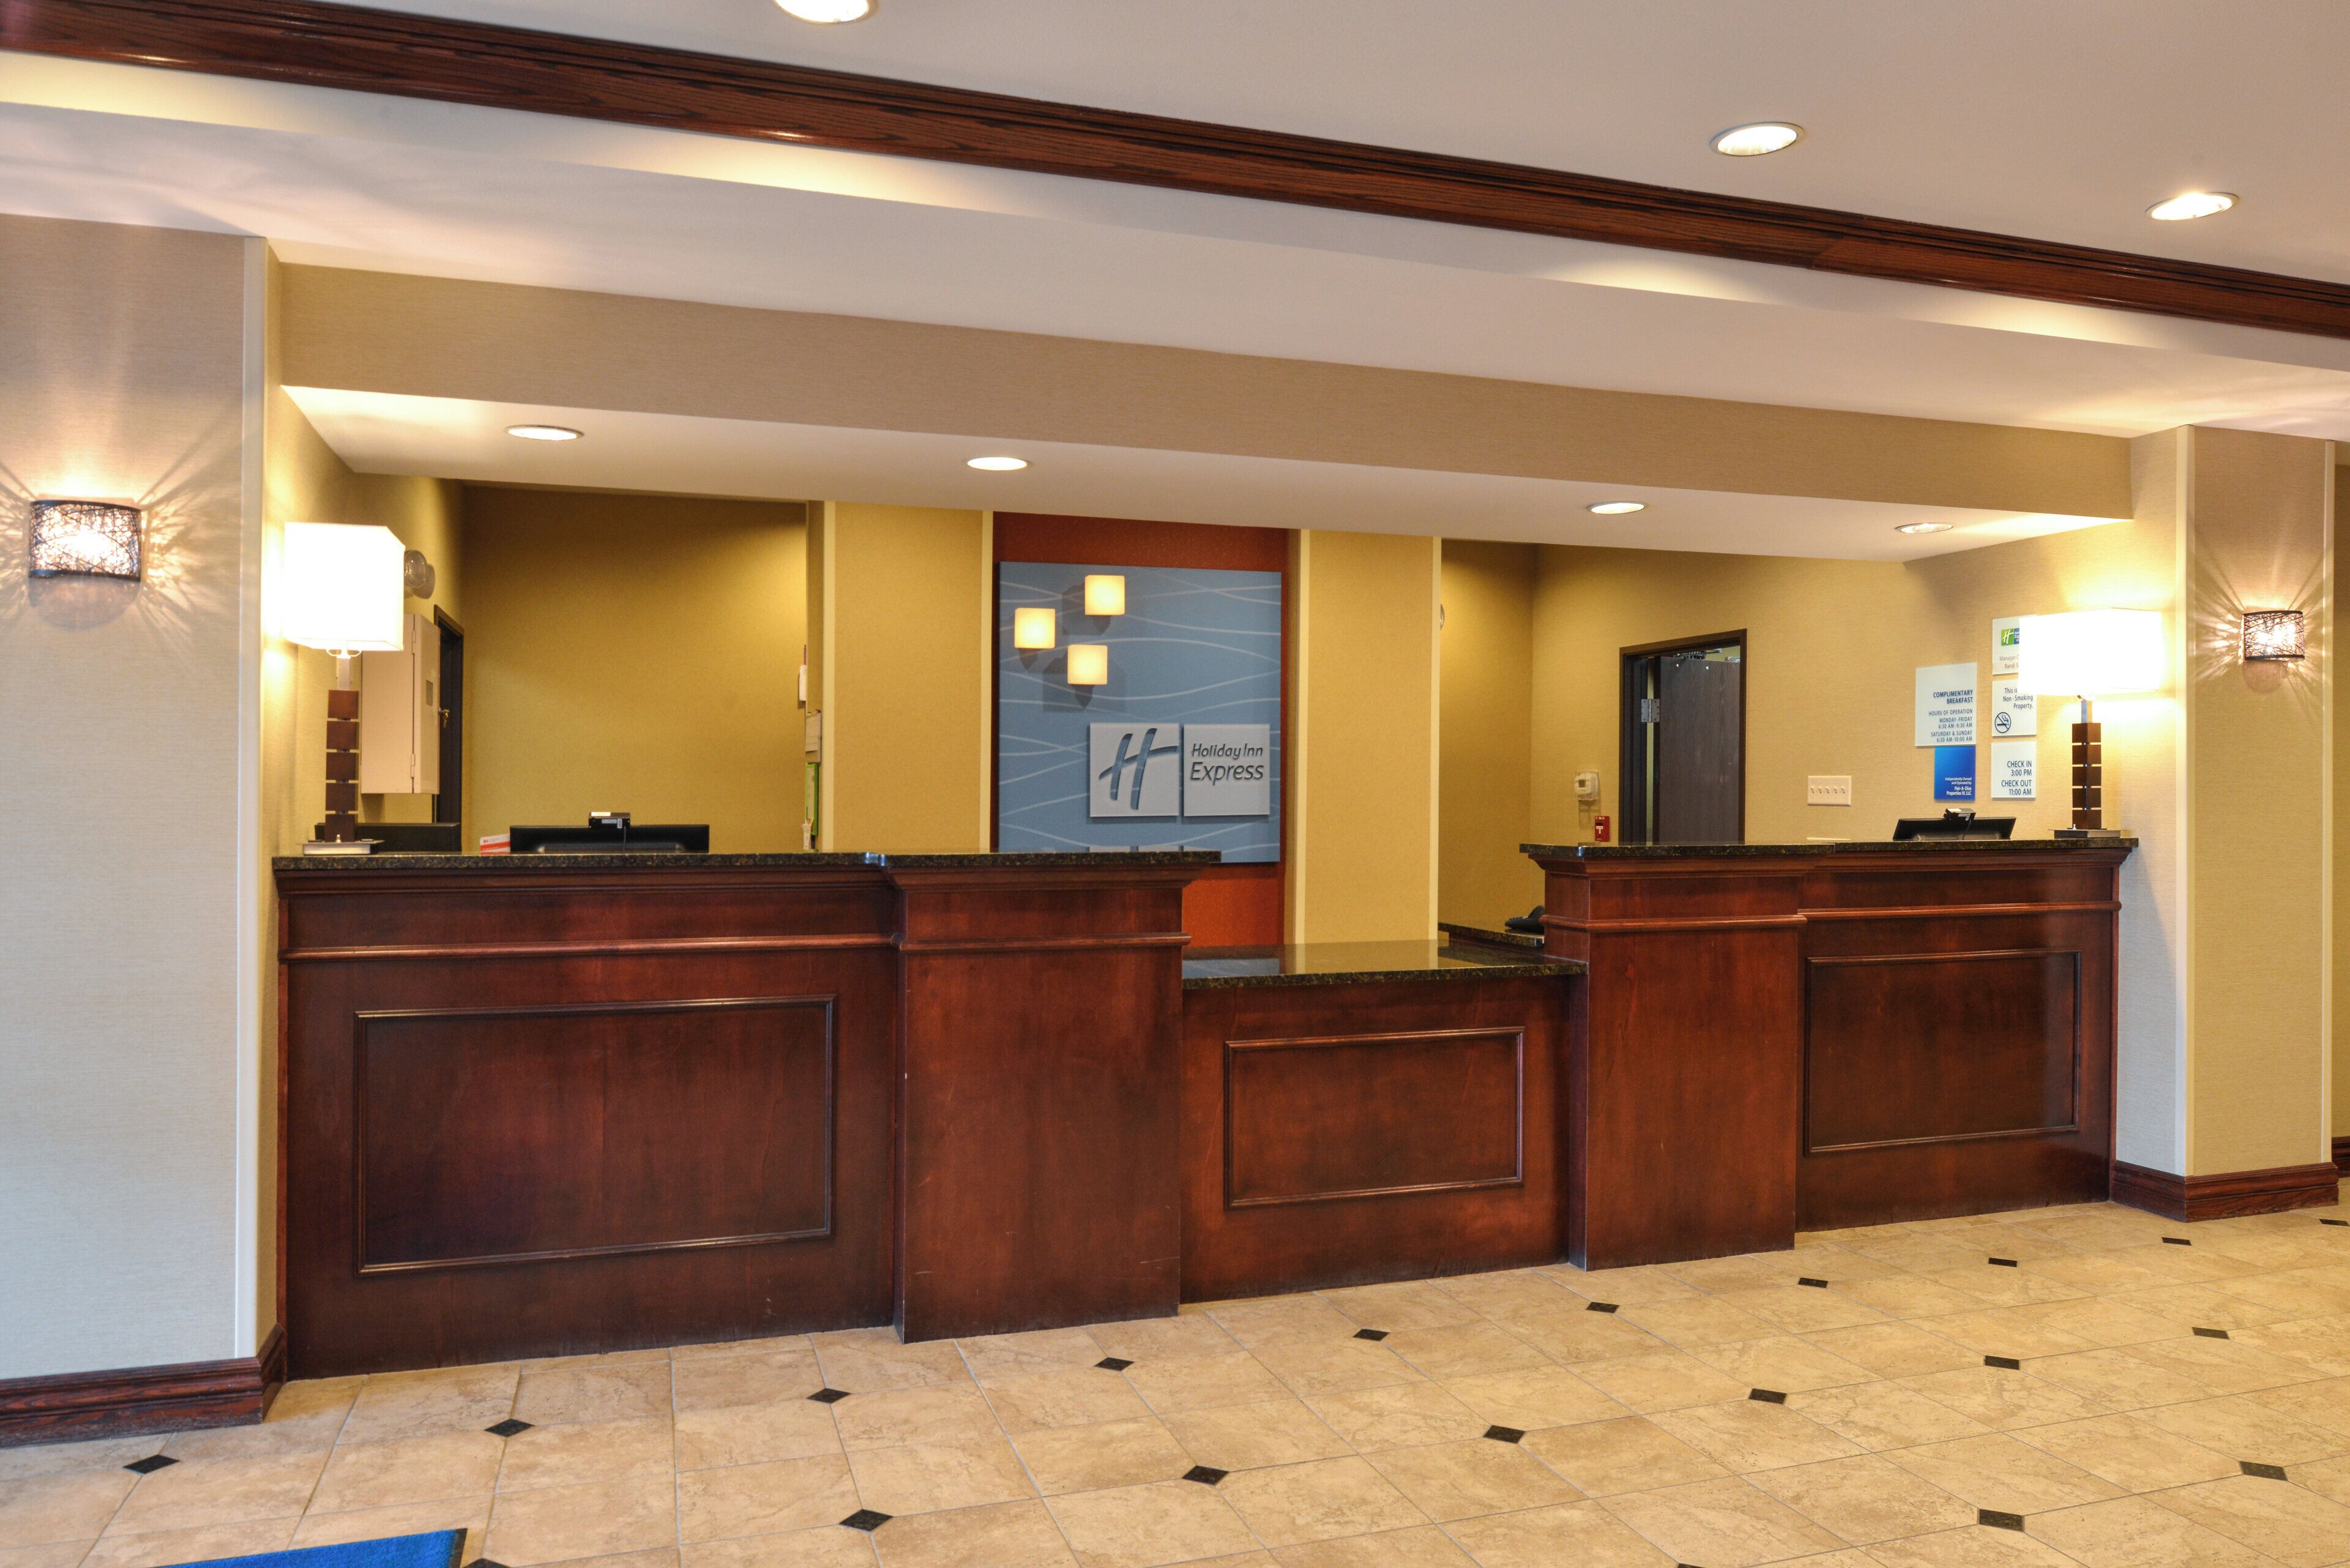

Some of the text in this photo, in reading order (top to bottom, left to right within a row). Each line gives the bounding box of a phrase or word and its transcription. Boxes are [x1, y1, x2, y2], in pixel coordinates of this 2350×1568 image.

[1933, 689, 1973, 698] COMPLIMENTARY
[1192, 743, 1264, 760] Holiday Inn
[1190, 761, 1264, 785] Express
